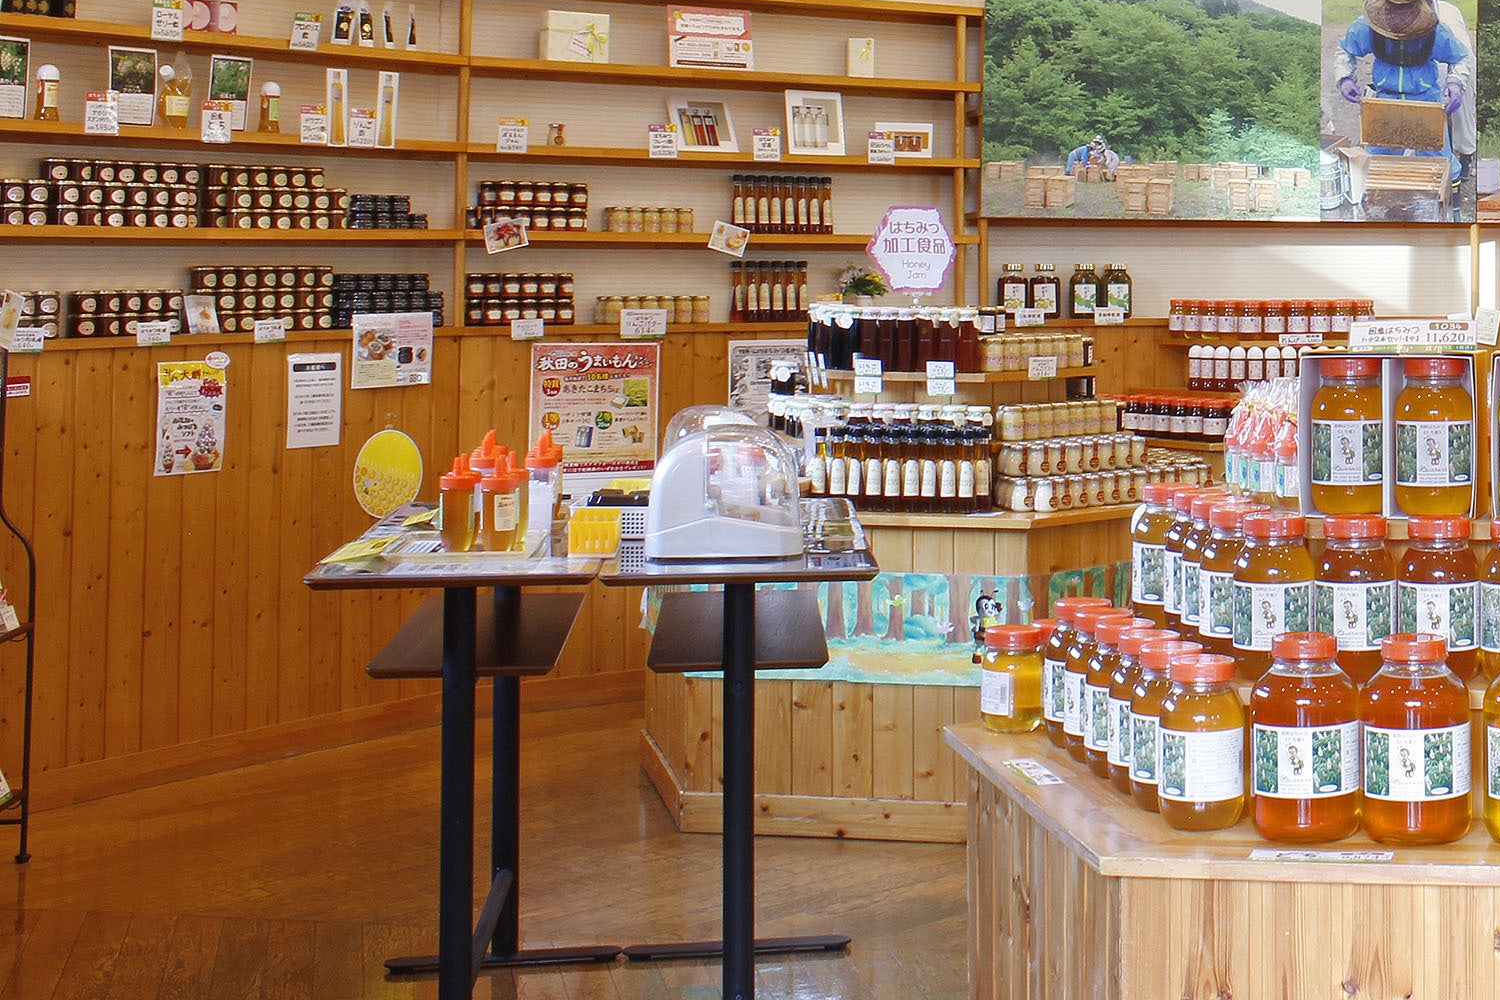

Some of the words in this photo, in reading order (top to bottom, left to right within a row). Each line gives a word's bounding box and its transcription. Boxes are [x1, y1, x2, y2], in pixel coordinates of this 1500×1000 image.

[889, 221, 940, 234] はちみつ
[883, 237, 946, 255] 加工食品
[902, 260, 931, 270] Honey
[907, 270, 927, 280] Jam
[1368, 326, 1420, 335] 国産はちみつ
[536, 350, 639, 373] 秋田のうまいもん
